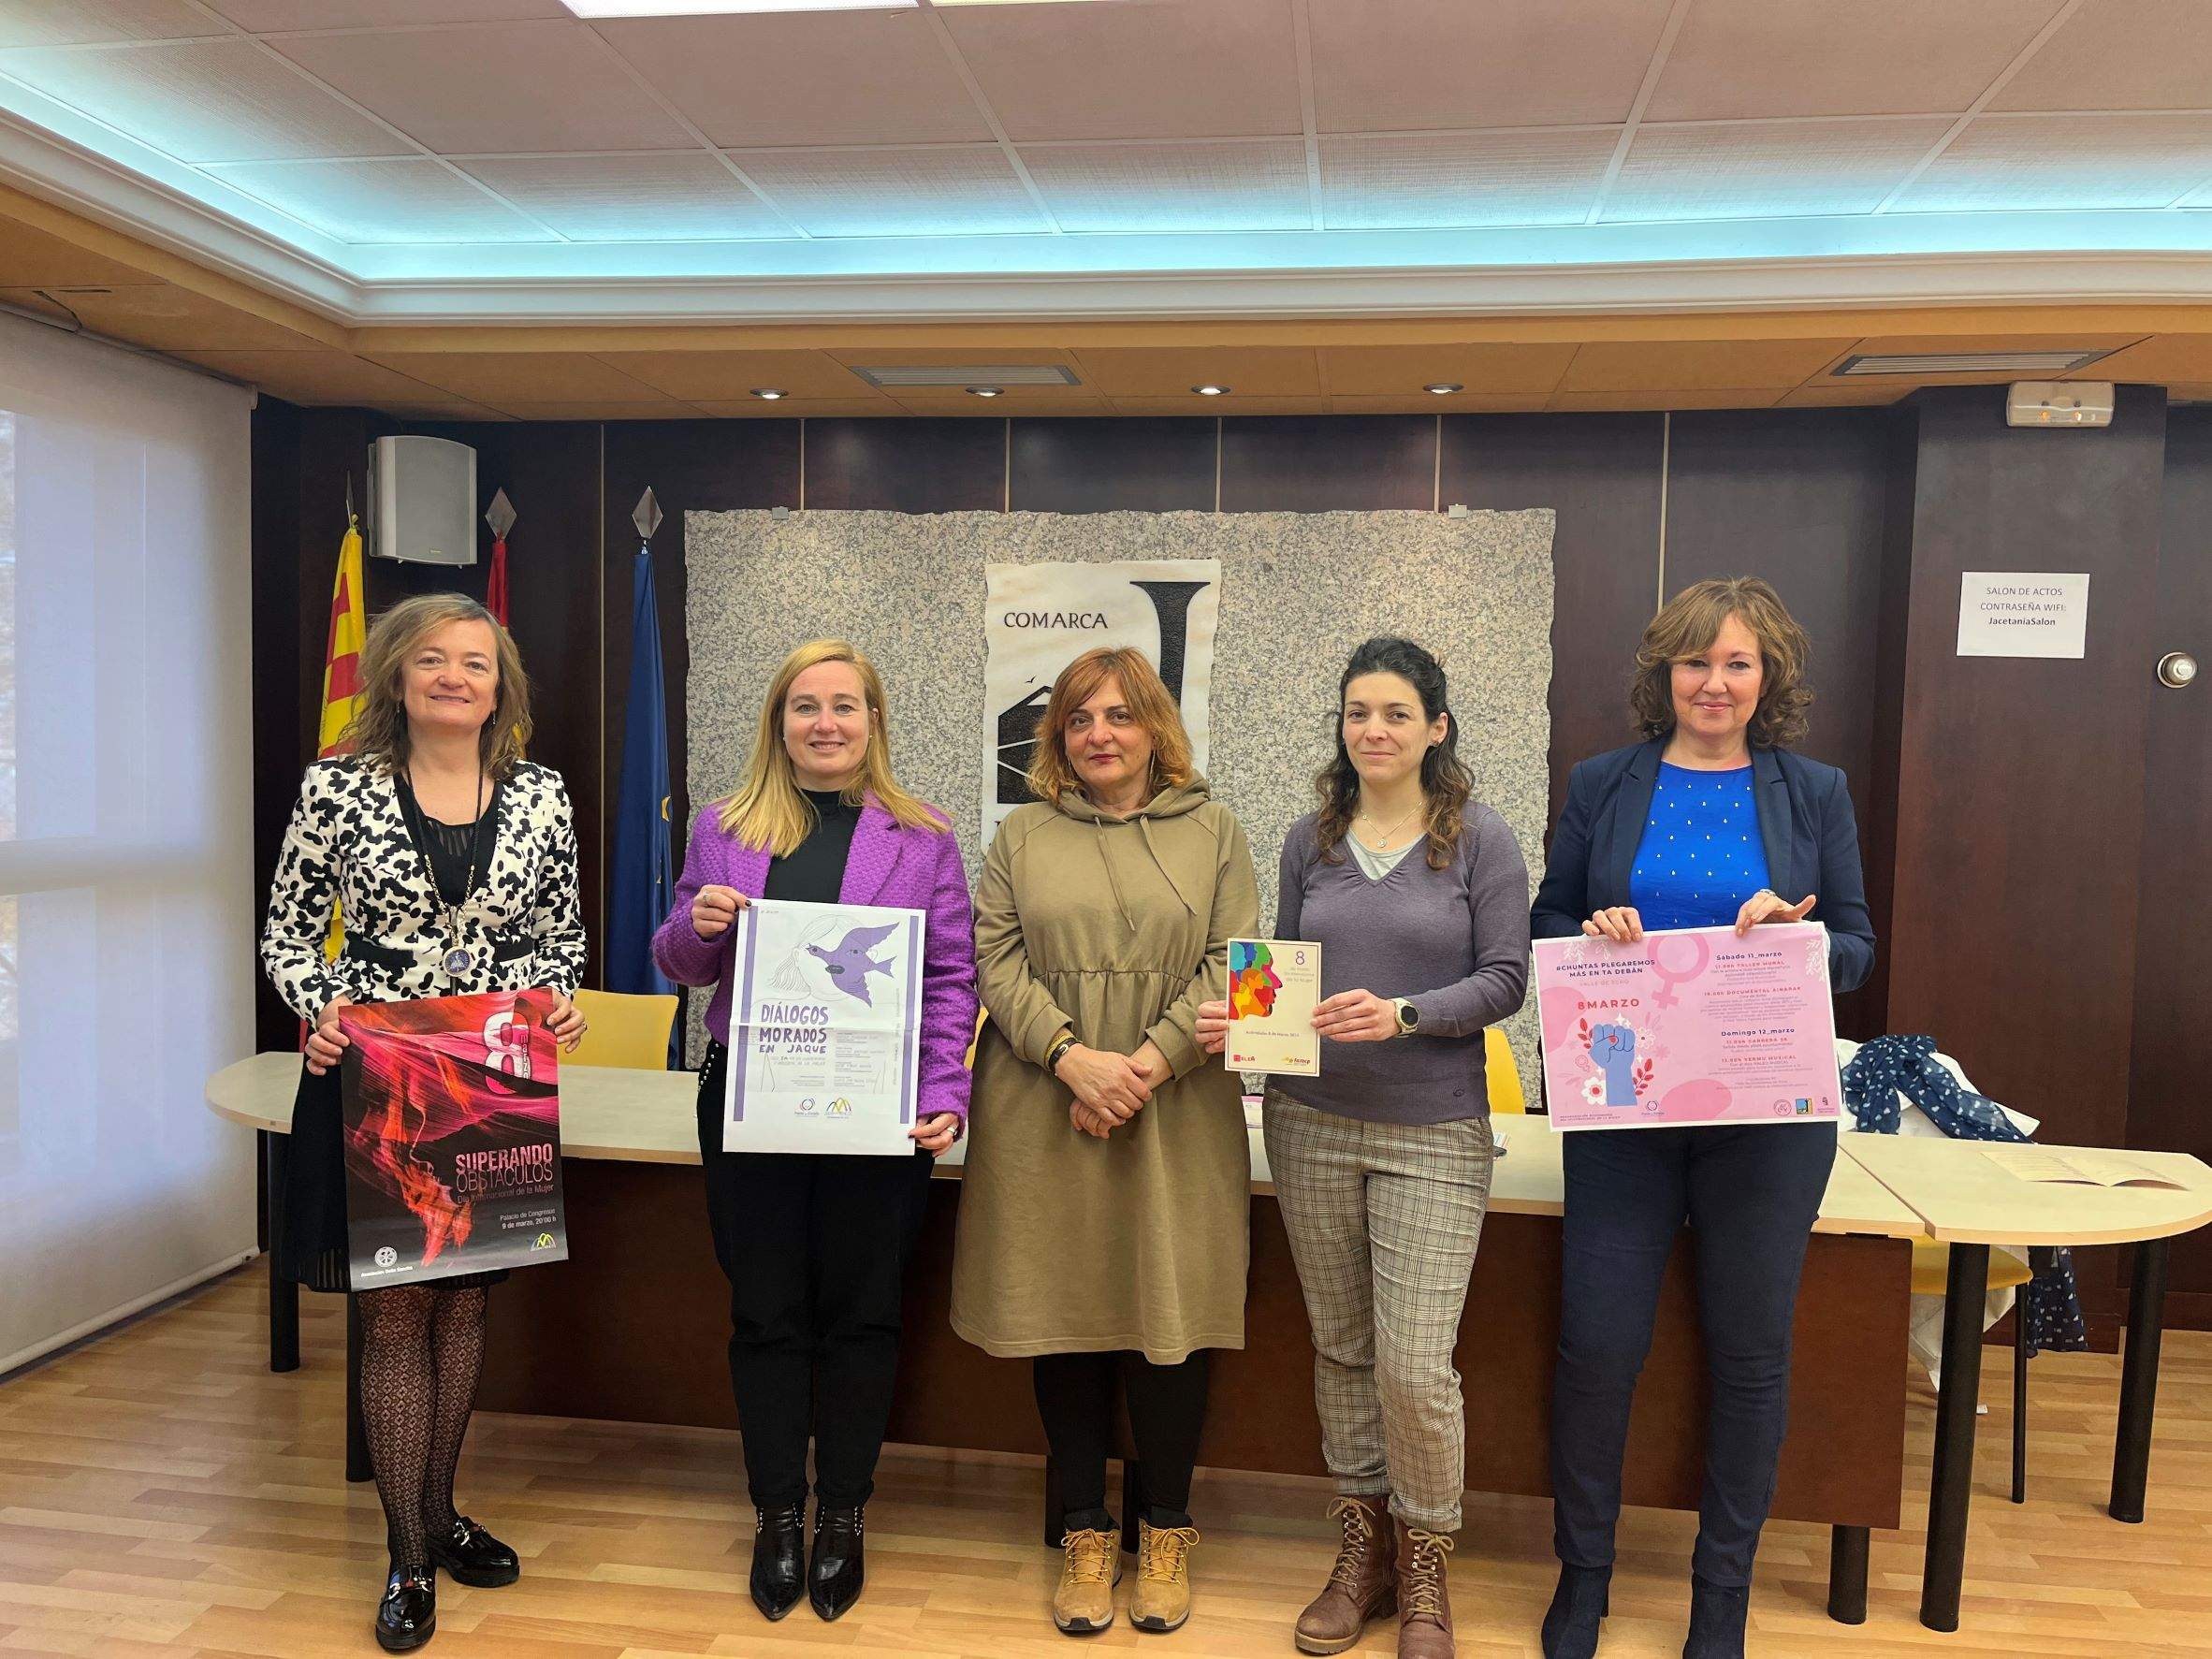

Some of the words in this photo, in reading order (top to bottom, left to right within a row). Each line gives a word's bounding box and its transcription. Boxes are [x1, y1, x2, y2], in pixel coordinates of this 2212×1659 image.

[2033, 588, 2062, 596] ACTOS
[1981, 602, 2041, 611] CONTRASEÑA
[1004, 612, 1109, 629] COMARCA
[1988, 618, 2056, 626] JacetaniaSalon
[1295, 951, 1305, 965] 8
[1601, 959, 1655, 968] PLEGAREMOS
[762, 1001, 829, 1026] DIÁLOGOS
[759, 1027, 827, 1044] MORADOS
[759, 1045, 776, 1054] EN
[787, 1045, 827, 1055] JAQUE
[456, 1143, 553, 1174] SUPERANDO
[534, 1184, 554, 1194] Mujer
